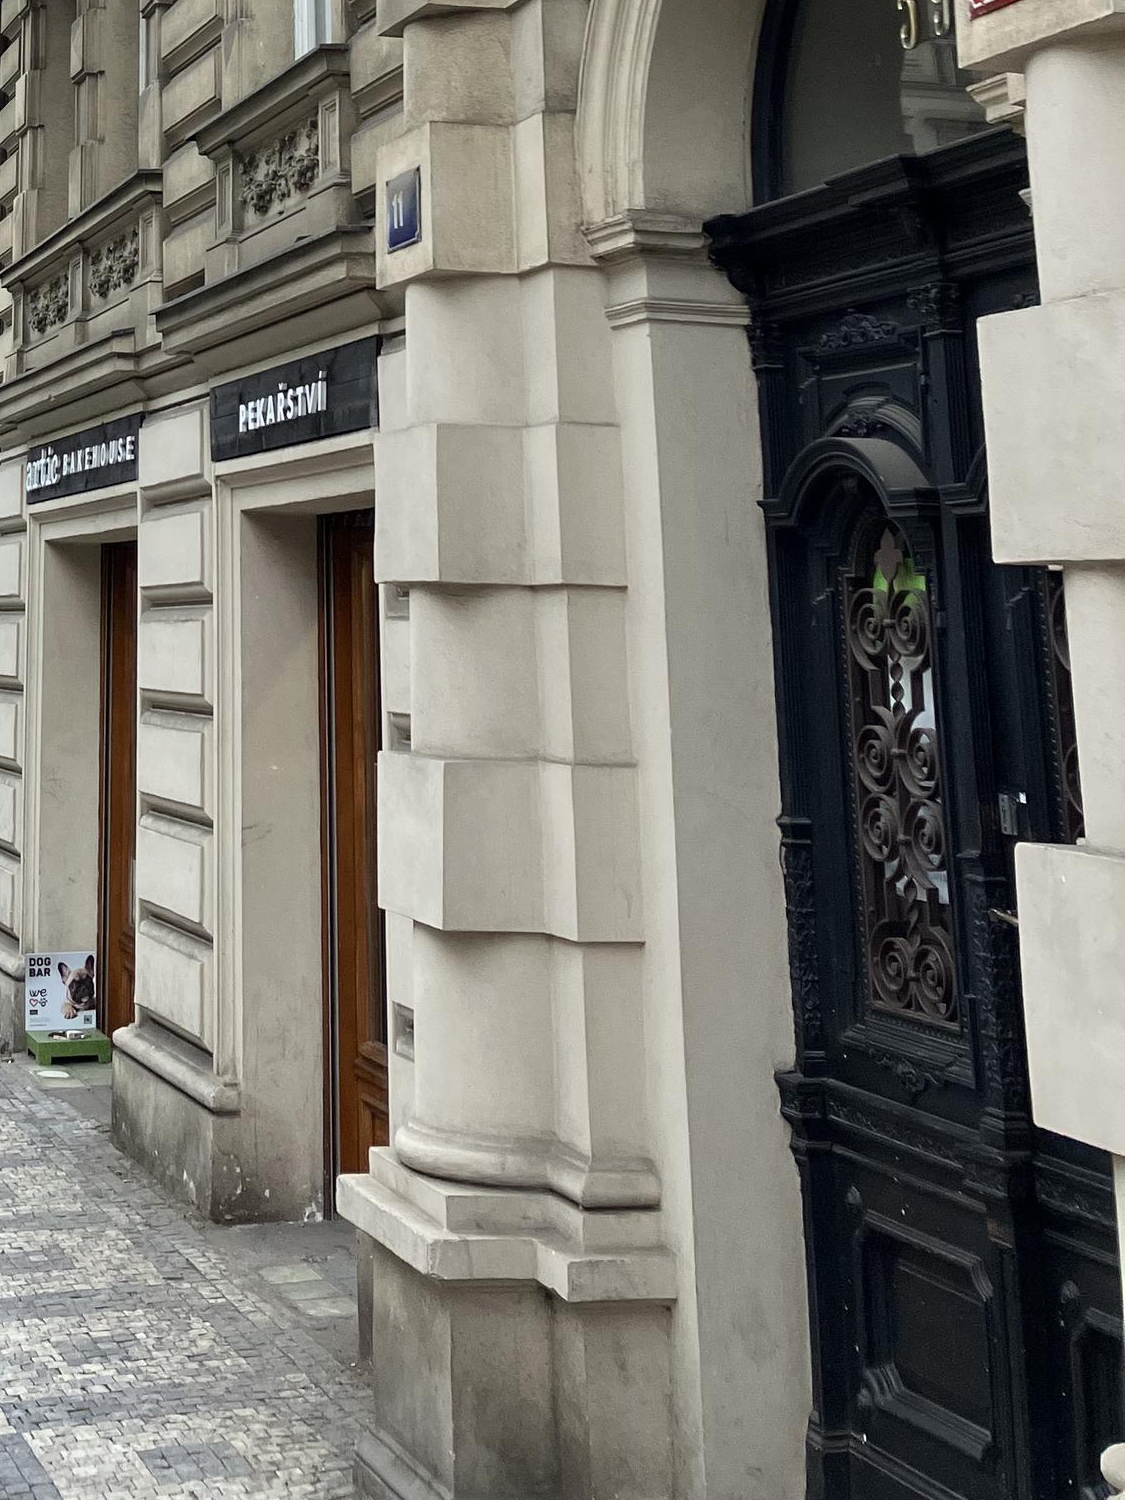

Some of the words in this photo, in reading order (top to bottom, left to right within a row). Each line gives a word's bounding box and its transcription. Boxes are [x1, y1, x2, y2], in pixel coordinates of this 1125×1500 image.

[391, 190, 404, 230] 11
[238, 370, 327, 433] PEKAŘSTVÍ
[26, 446, 61, 493] artic
[62, 435, 135, 477] BAKEHOUSE
[29, 957, 51, 967] DOG
[29, 968, 51, 977] BAR
[29, 988, 48, 997] we
